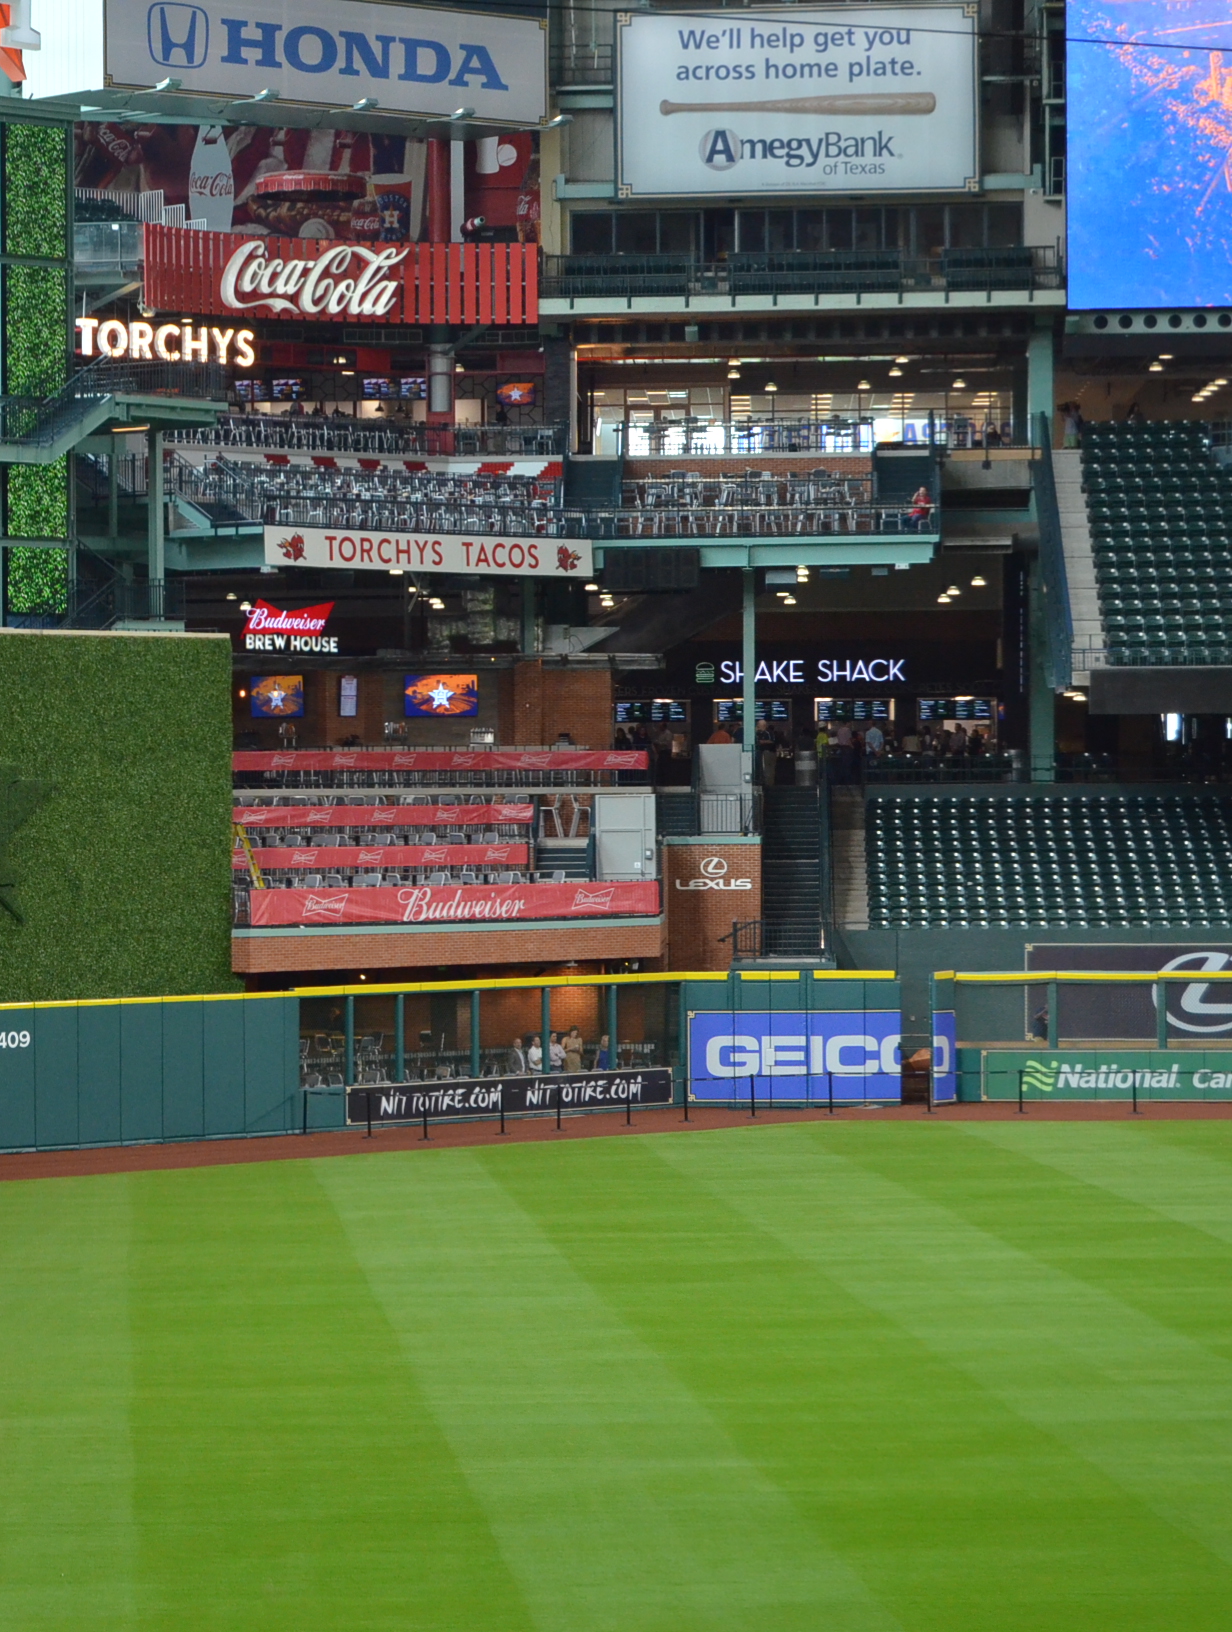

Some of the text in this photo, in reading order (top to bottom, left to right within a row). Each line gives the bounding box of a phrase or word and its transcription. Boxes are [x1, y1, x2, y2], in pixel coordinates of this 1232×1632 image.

[220, 17, 509, 92] HONDA
[678, 28, 911, 55] We'll help get you
[675, 56, 922, 82] across home plate.
[822, 161, 886, 175] of Texas
[220, 240, 410, 316] Coca-Cola
[75, 318, 255, 367] TORCHYS
[325, 535, 539, 569] TORCHYS TACOS
[246, 607, 326, 631] Budweiser
[245, 633, 339, 653] BREW HOUSE
[719, 658, 907, 684] SHAKE SHACK
[675, 878, 753, 890] LEXUS
[397, 887, 526, 922] Budweiser
